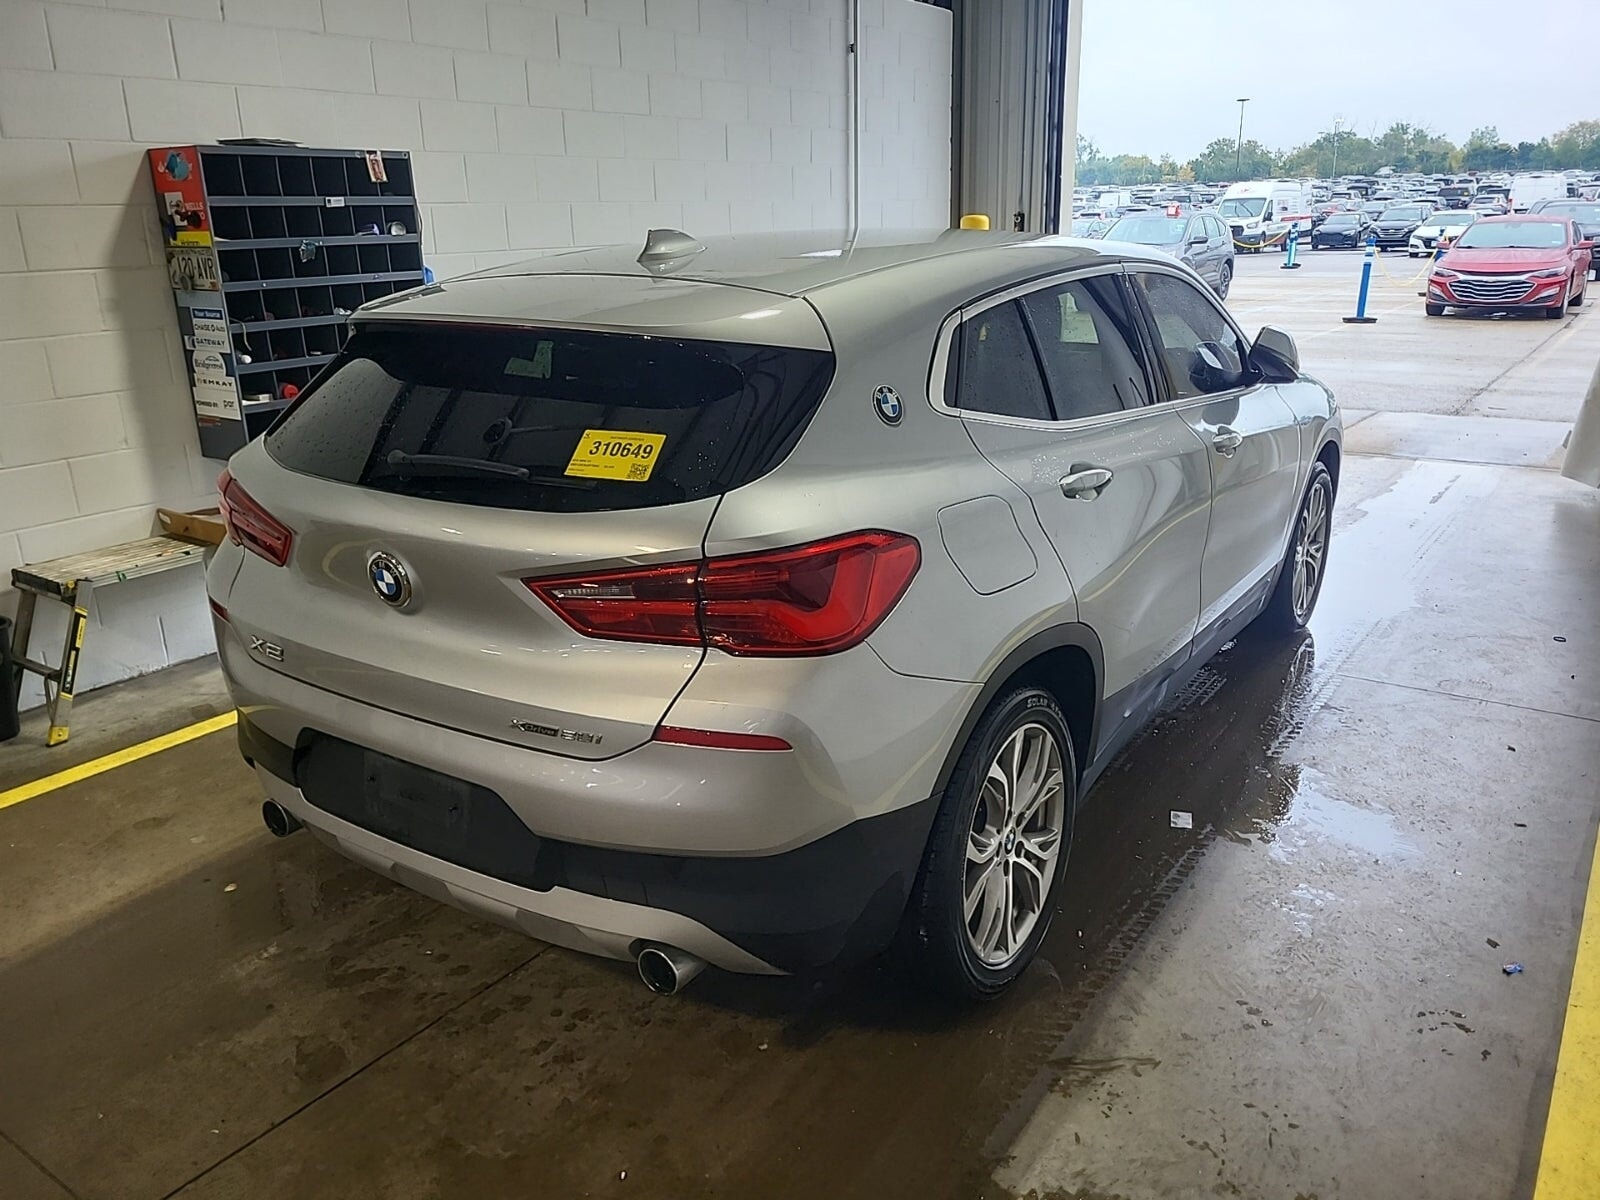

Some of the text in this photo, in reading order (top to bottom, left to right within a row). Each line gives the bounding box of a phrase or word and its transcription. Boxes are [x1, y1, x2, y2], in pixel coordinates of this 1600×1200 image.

[202, 378, 233, 387] EMKAY
[589, 440, 654, 460] 310649
[250, 634, 284, 662] X2
